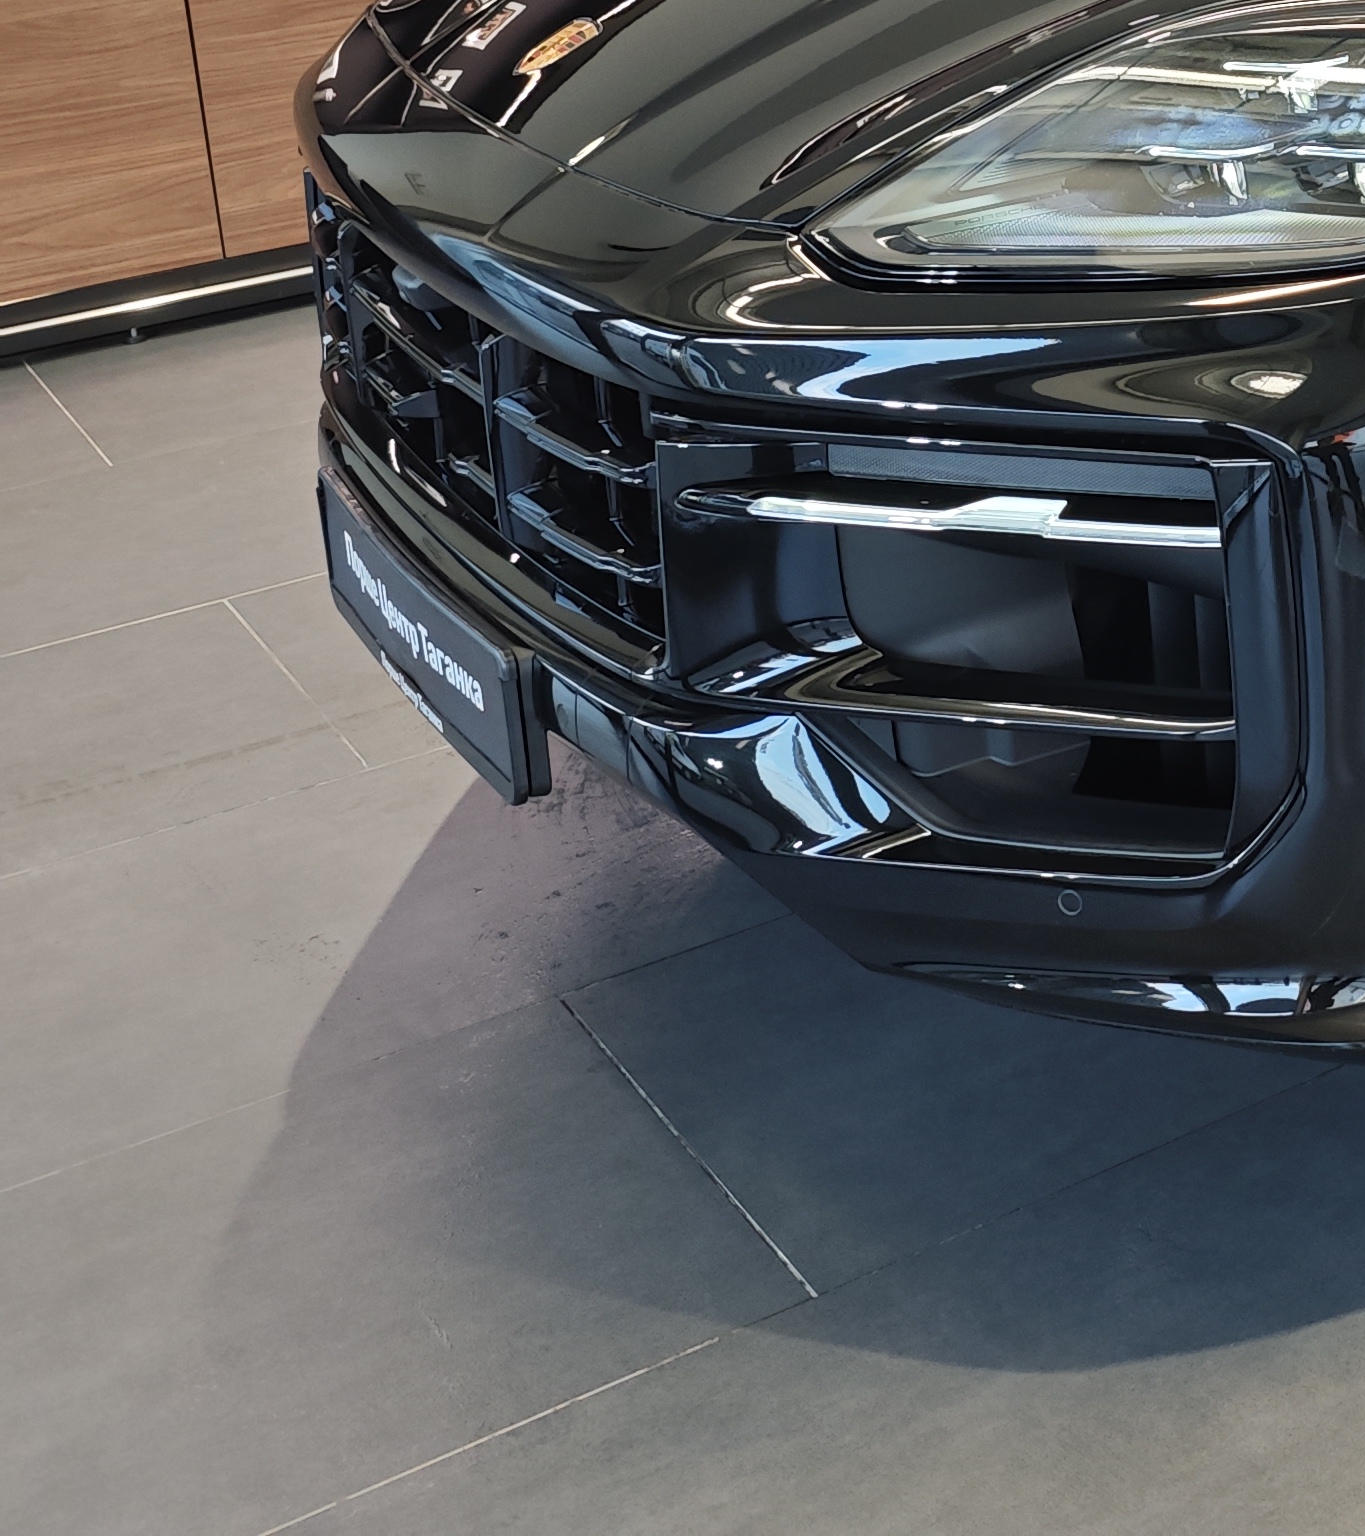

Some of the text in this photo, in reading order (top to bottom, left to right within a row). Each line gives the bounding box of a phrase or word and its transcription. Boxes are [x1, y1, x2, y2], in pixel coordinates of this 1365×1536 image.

[344, 530, 485, 712] Порше Центр Таганка
